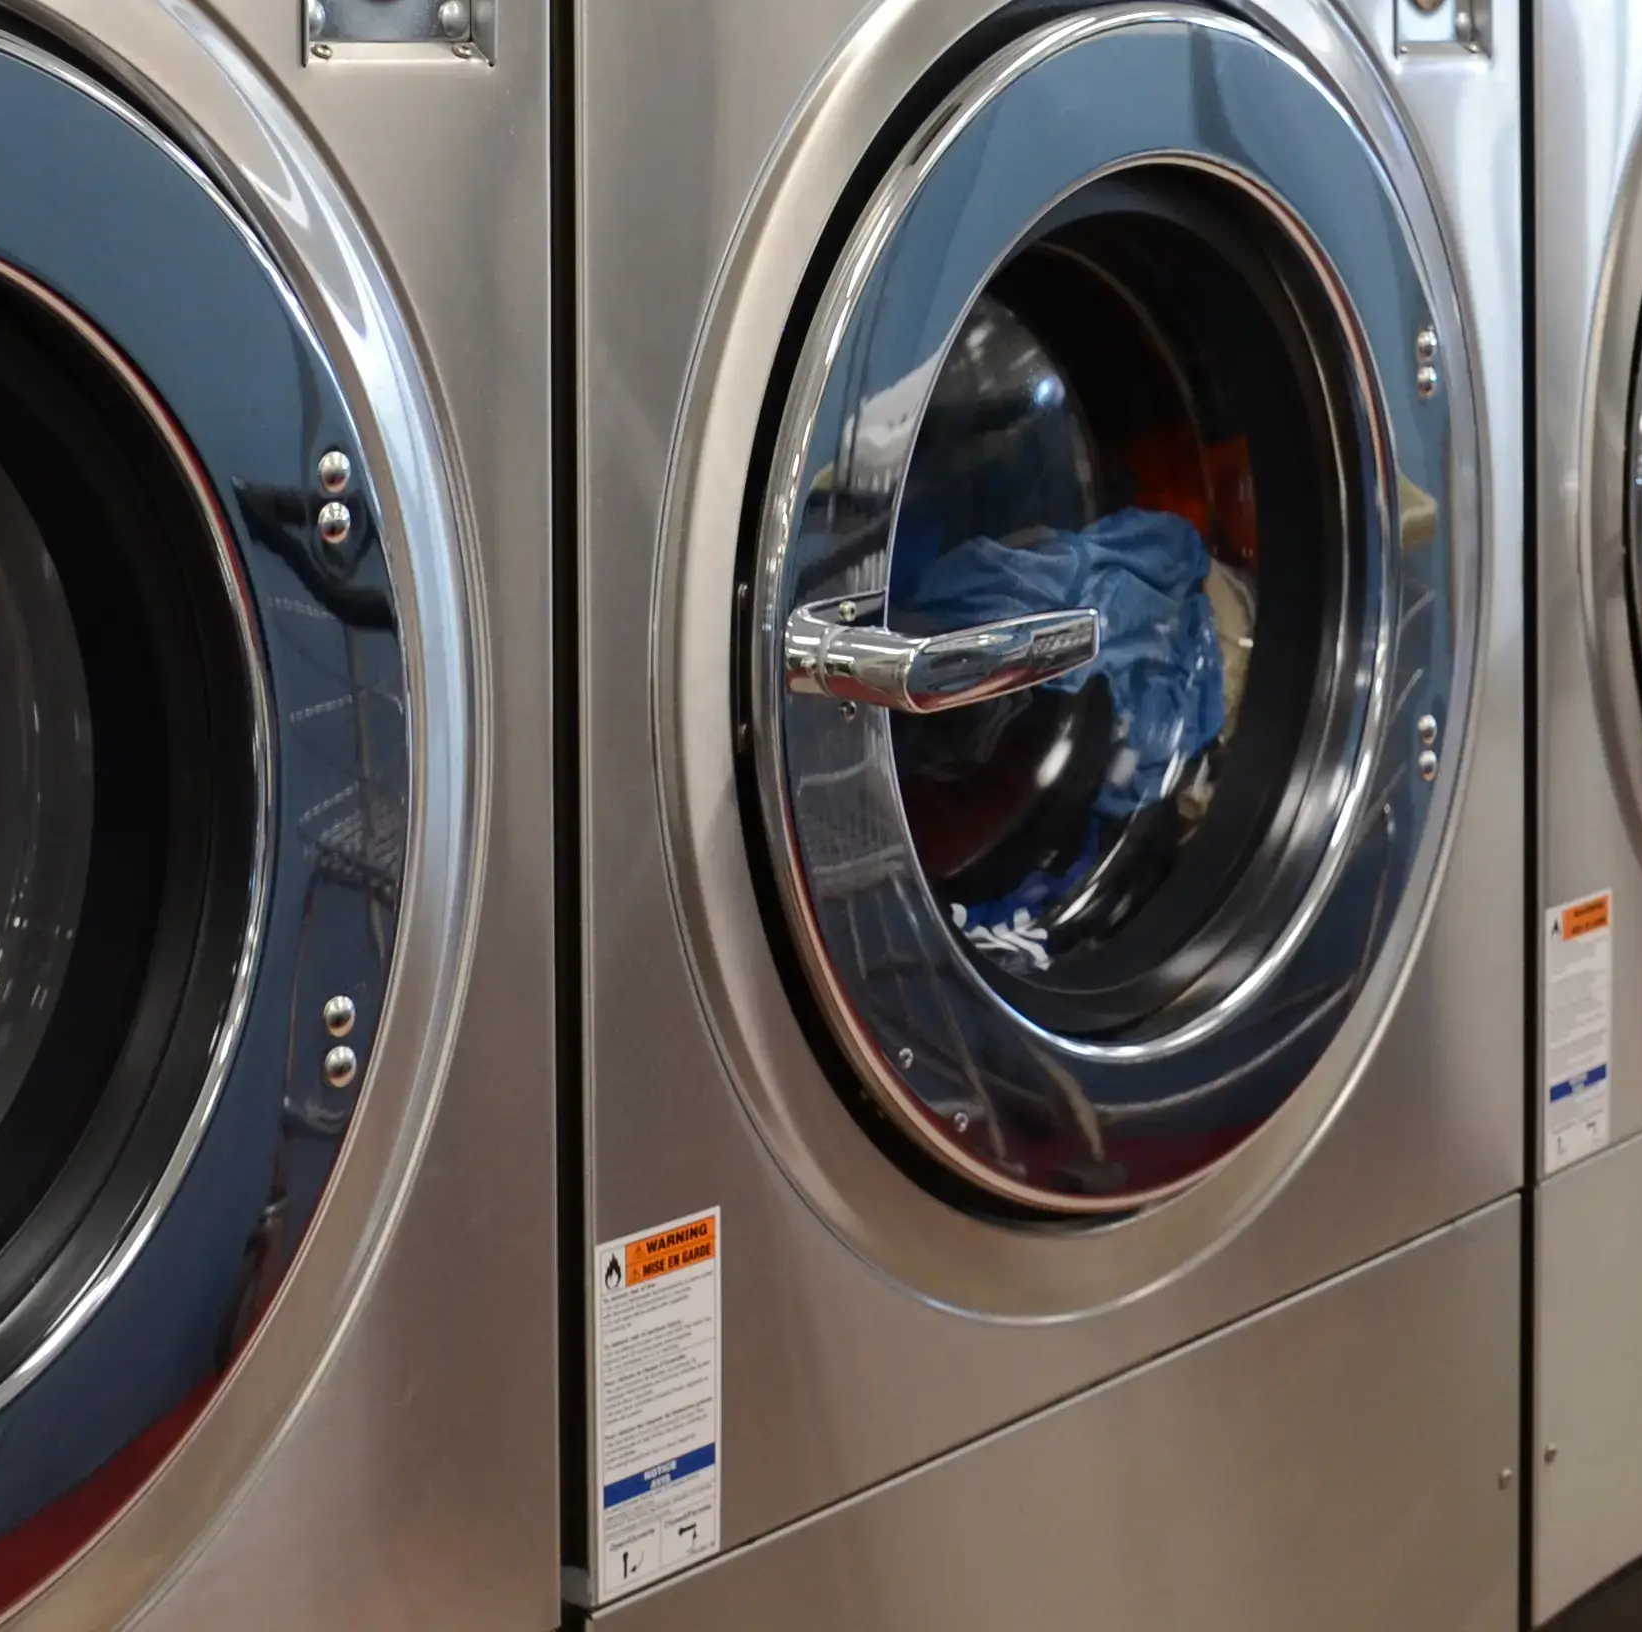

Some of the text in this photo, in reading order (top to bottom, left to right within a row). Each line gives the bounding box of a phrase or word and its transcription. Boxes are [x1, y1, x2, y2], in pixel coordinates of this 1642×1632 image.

[646, 1223, 707, 1254] WARNING
[643, 1241, 710, 1277] MISE EN GARDE
